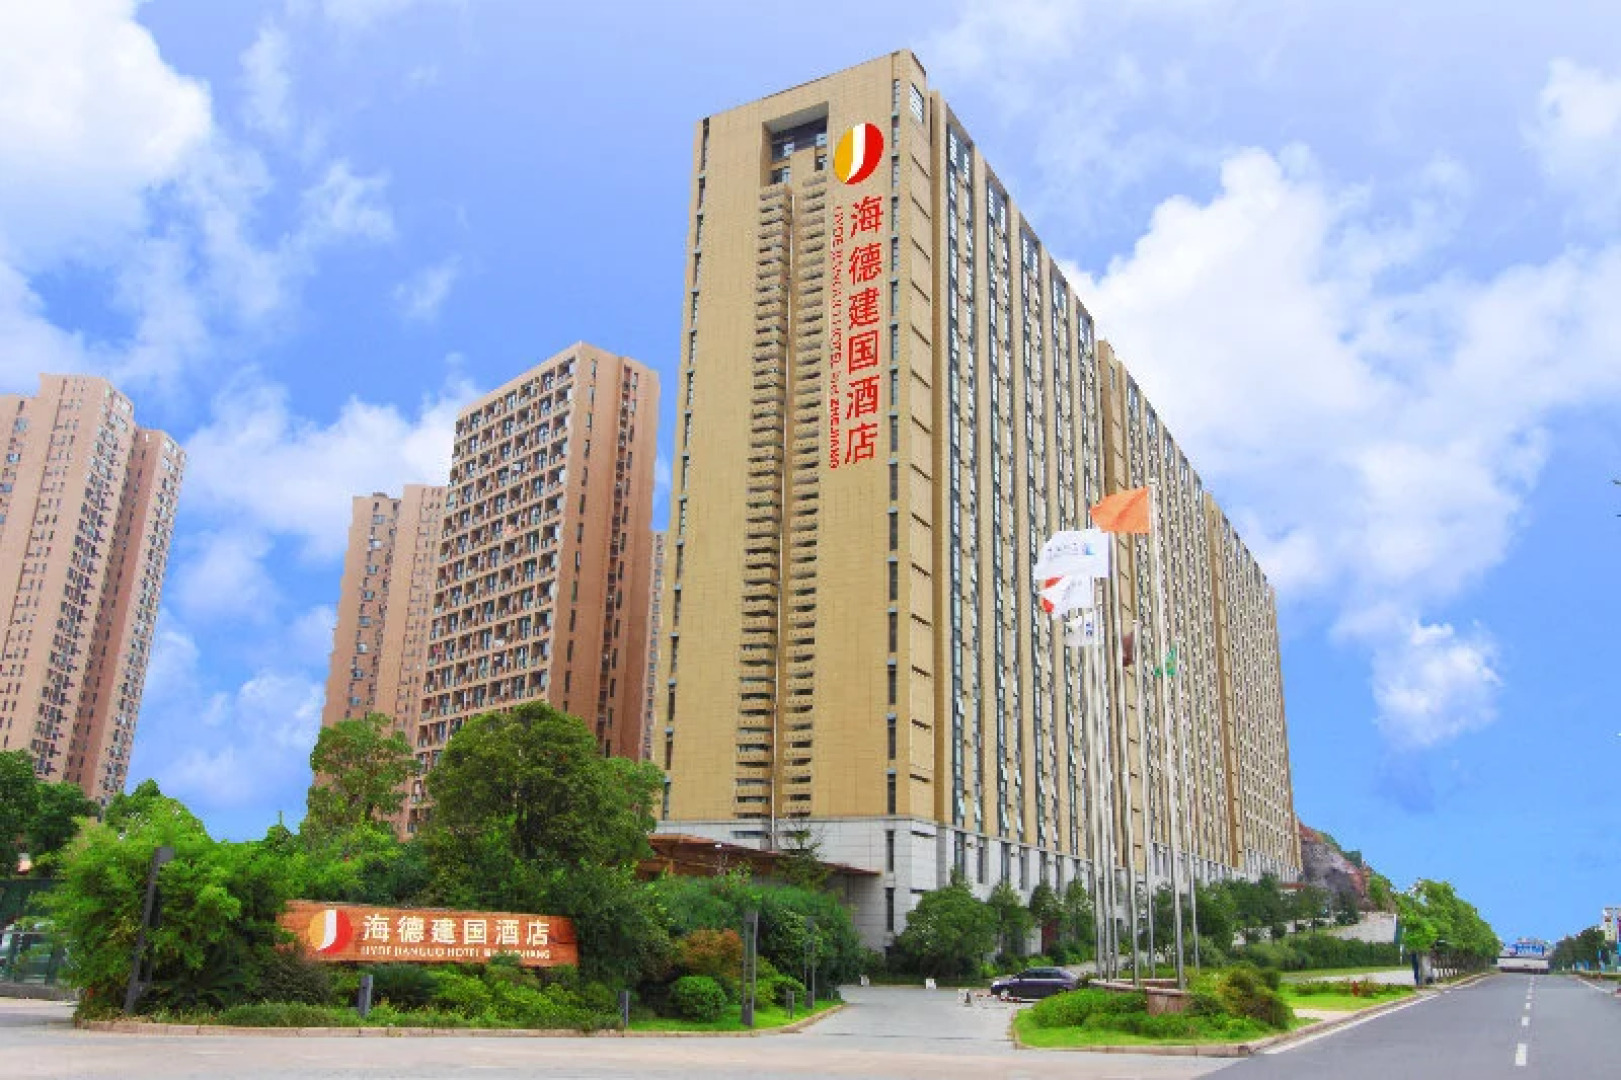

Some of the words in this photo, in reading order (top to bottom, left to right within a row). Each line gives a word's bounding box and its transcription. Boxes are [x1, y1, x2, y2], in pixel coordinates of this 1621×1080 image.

[845, 195, 883, 464] 海德建国酒店
[362, 913, 550, 947] 海德建国酒店
[394, 946, 445, 958] JIANGUO
